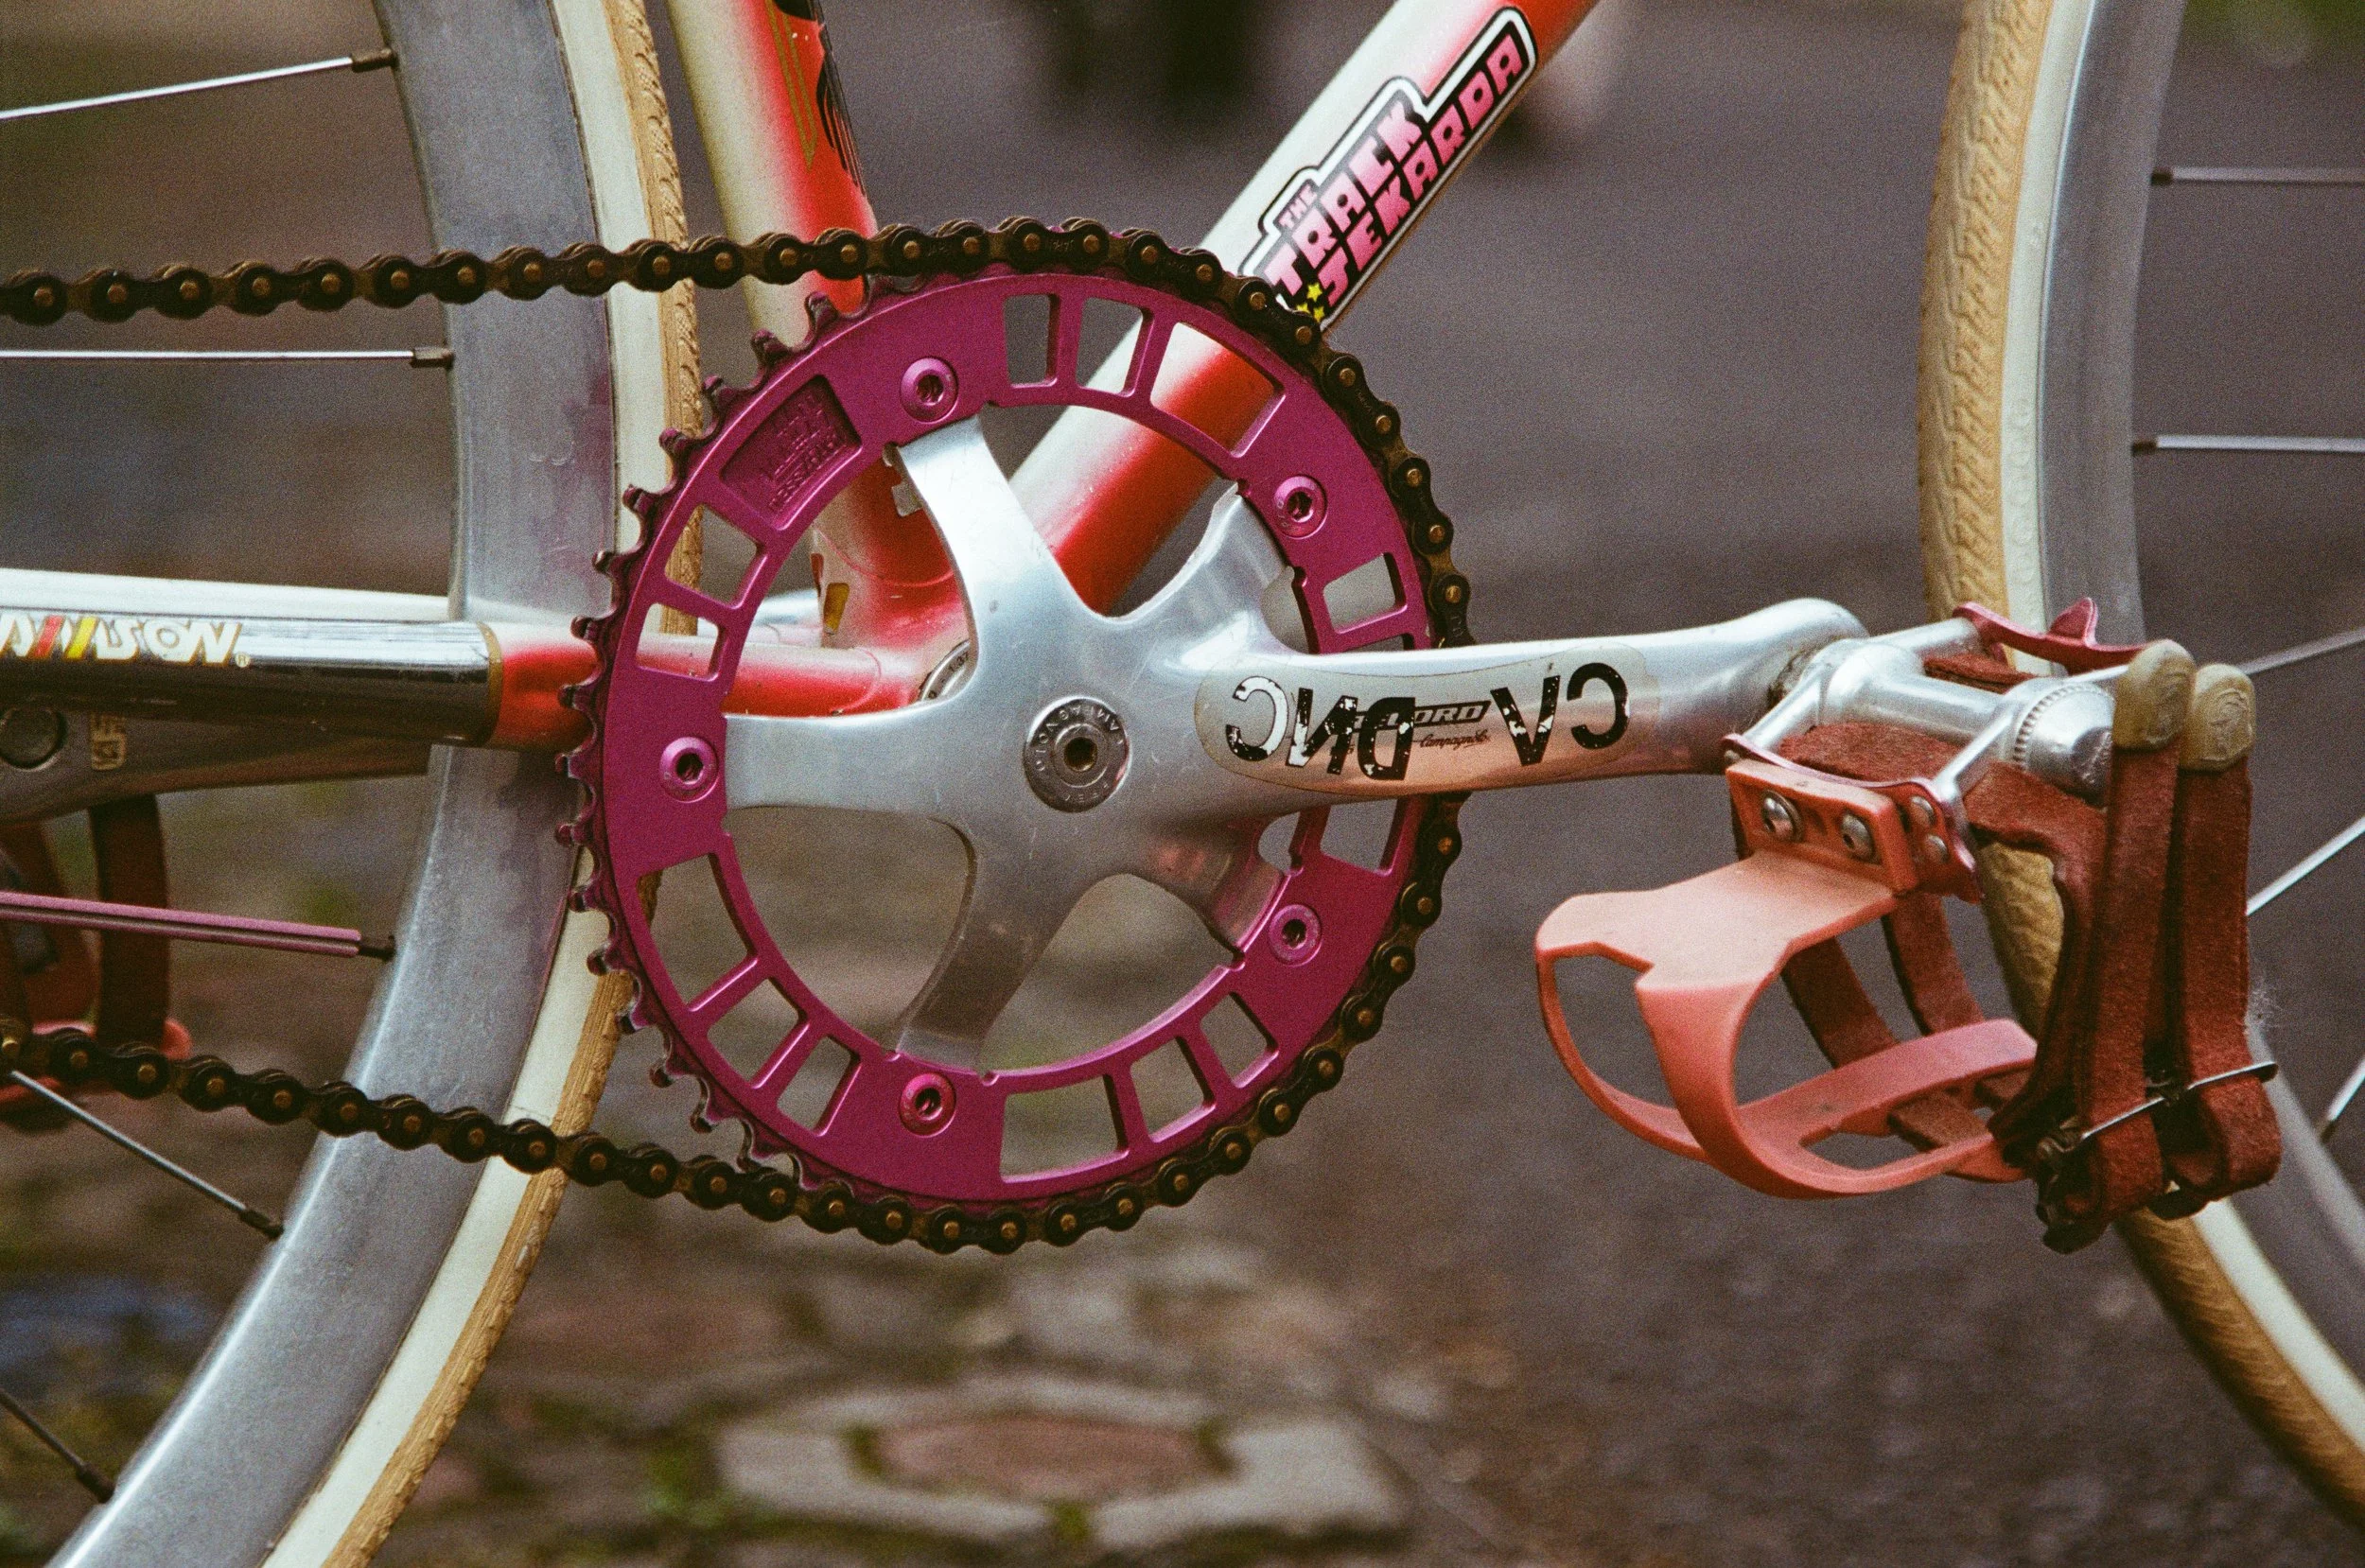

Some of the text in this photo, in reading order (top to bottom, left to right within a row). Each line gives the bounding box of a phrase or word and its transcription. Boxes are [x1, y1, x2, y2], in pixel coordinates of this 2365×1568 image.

[1264, 100, 1422, 296] TRACK
[1278, 184, 1318, 230] THE
[1318, 33, 1523, 306] JEKARDA
